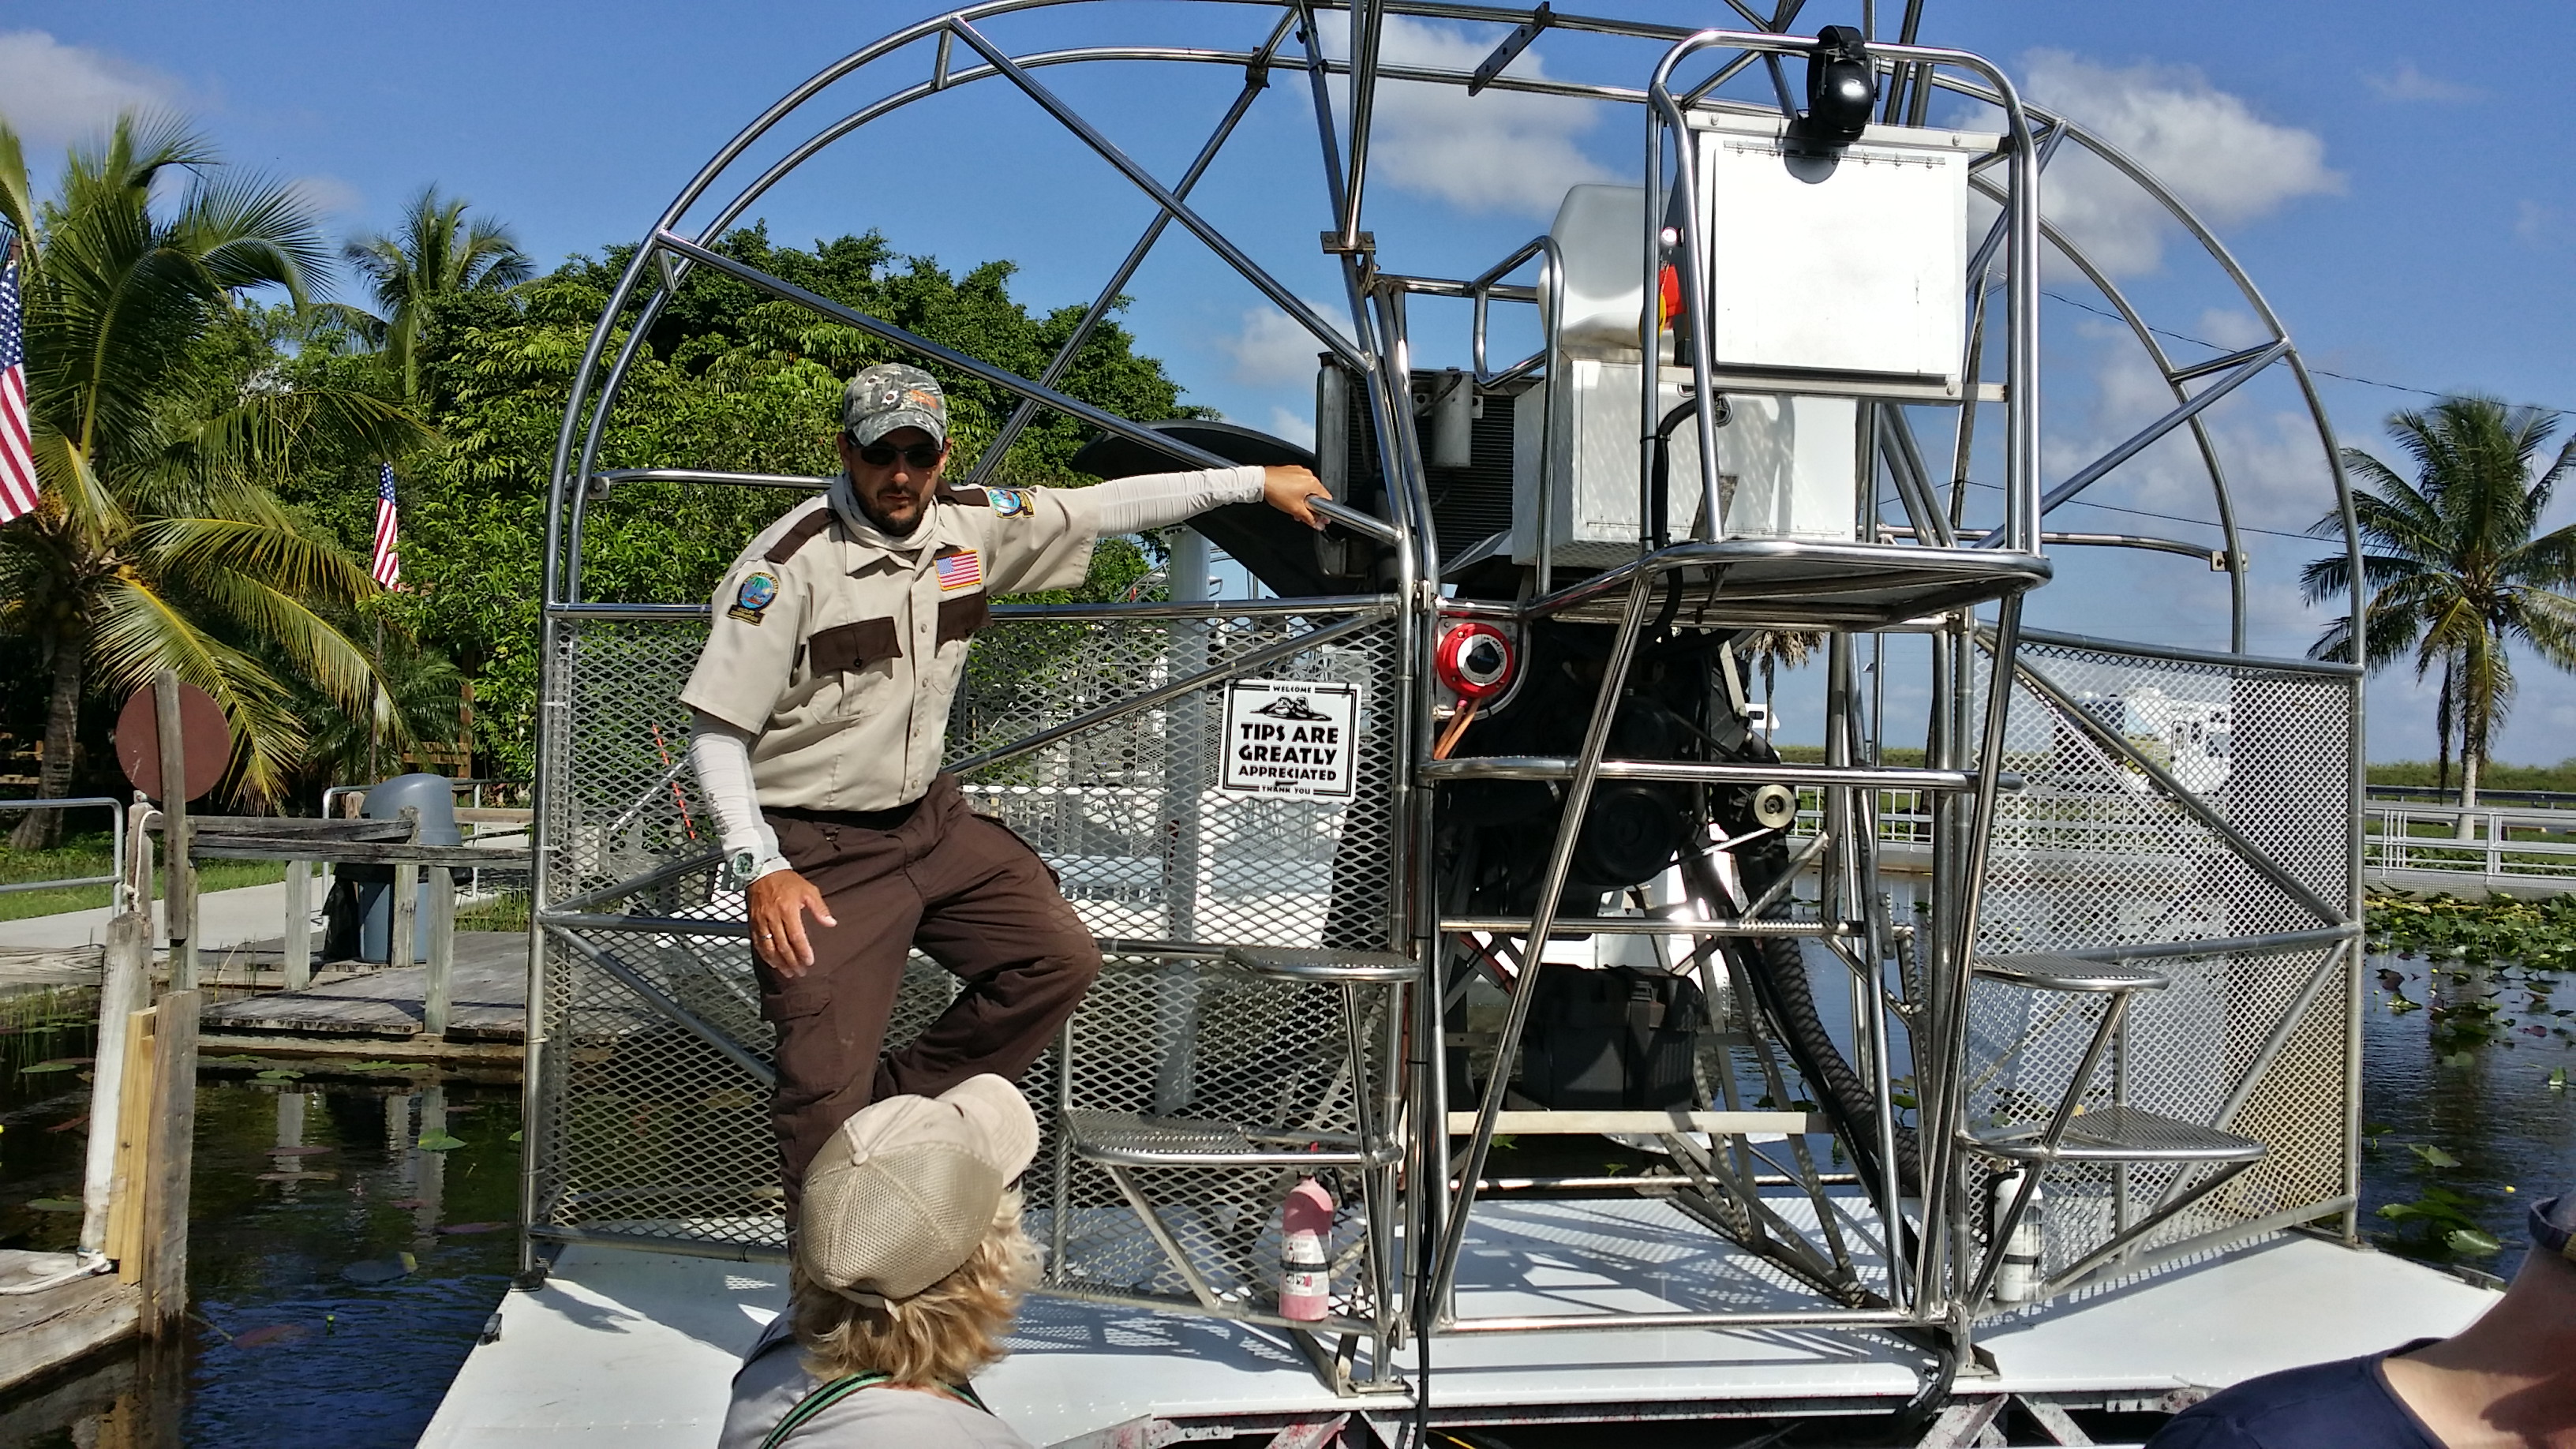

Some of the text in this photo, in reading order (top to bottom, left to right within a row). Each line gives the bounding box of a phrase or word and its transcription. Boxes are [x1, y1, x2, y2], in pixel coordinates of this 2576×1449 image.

[1241, 723, 1339, 744] TIPS ARE
[1238, 743, 1338, 765] GREATLY
[1238, 765, 1337, 781] APPRECIATED
